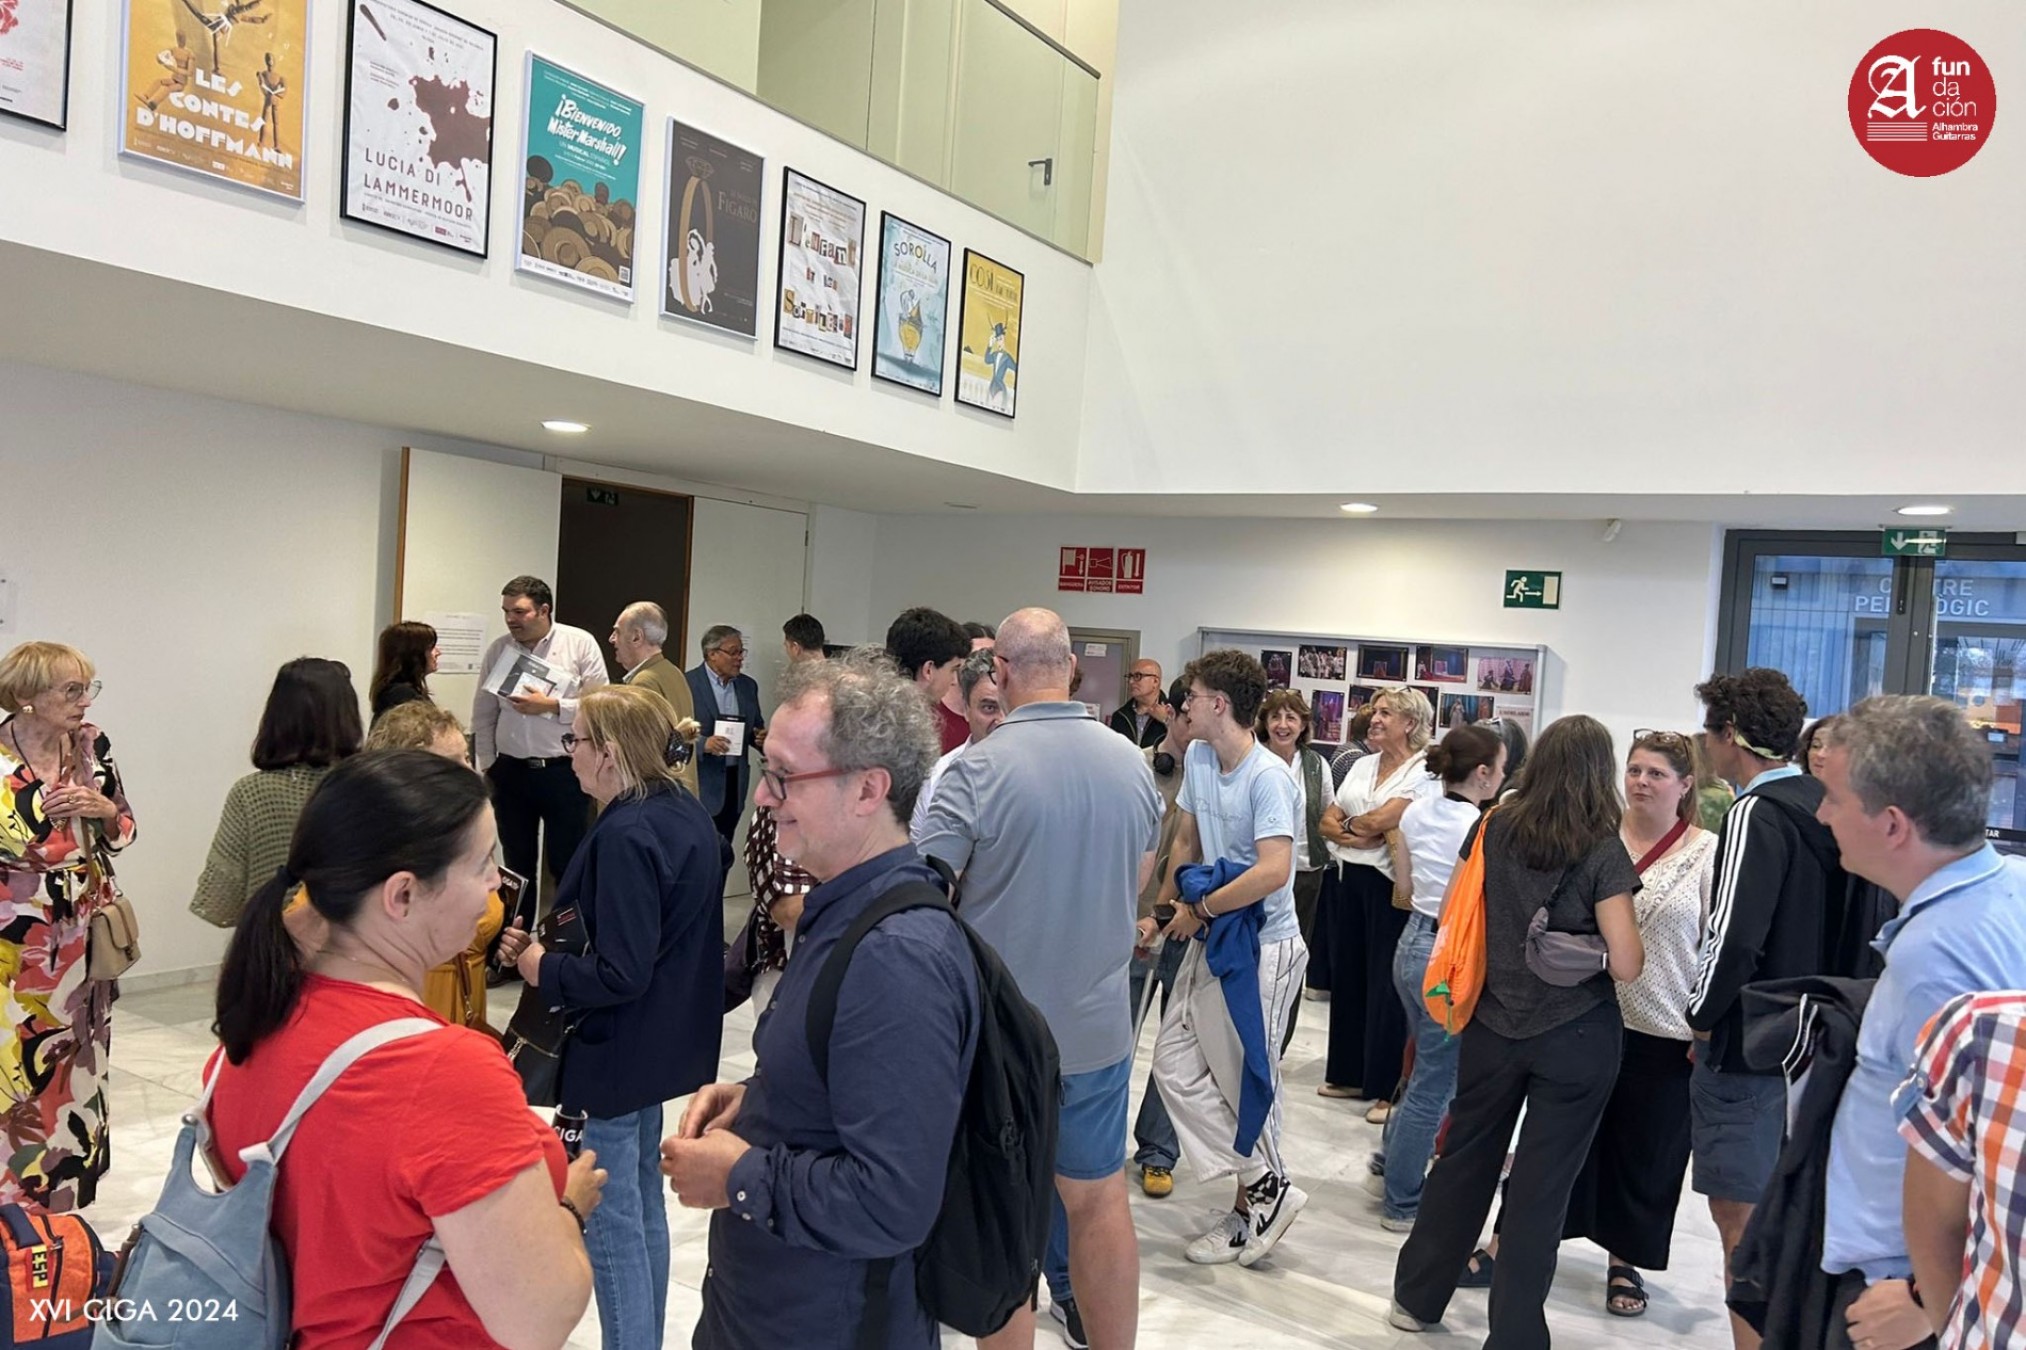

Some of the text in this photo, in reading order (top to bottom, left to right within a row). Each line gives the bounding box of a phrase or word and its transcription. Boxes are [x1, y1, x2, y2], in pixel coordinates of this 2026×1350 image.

[195, 68, 244, 98] LES
[168, 91, 267, 133] CONTES
[135, 107, 294, 170] D'HOFFMANN
[364, 147, 440, 187] LUCIA DI
[363, 174, 474, 222] LAMMERMOOR
[893, 241, 938, 274] SOROLLA
[32, 1251, 48, 1281] ESP
